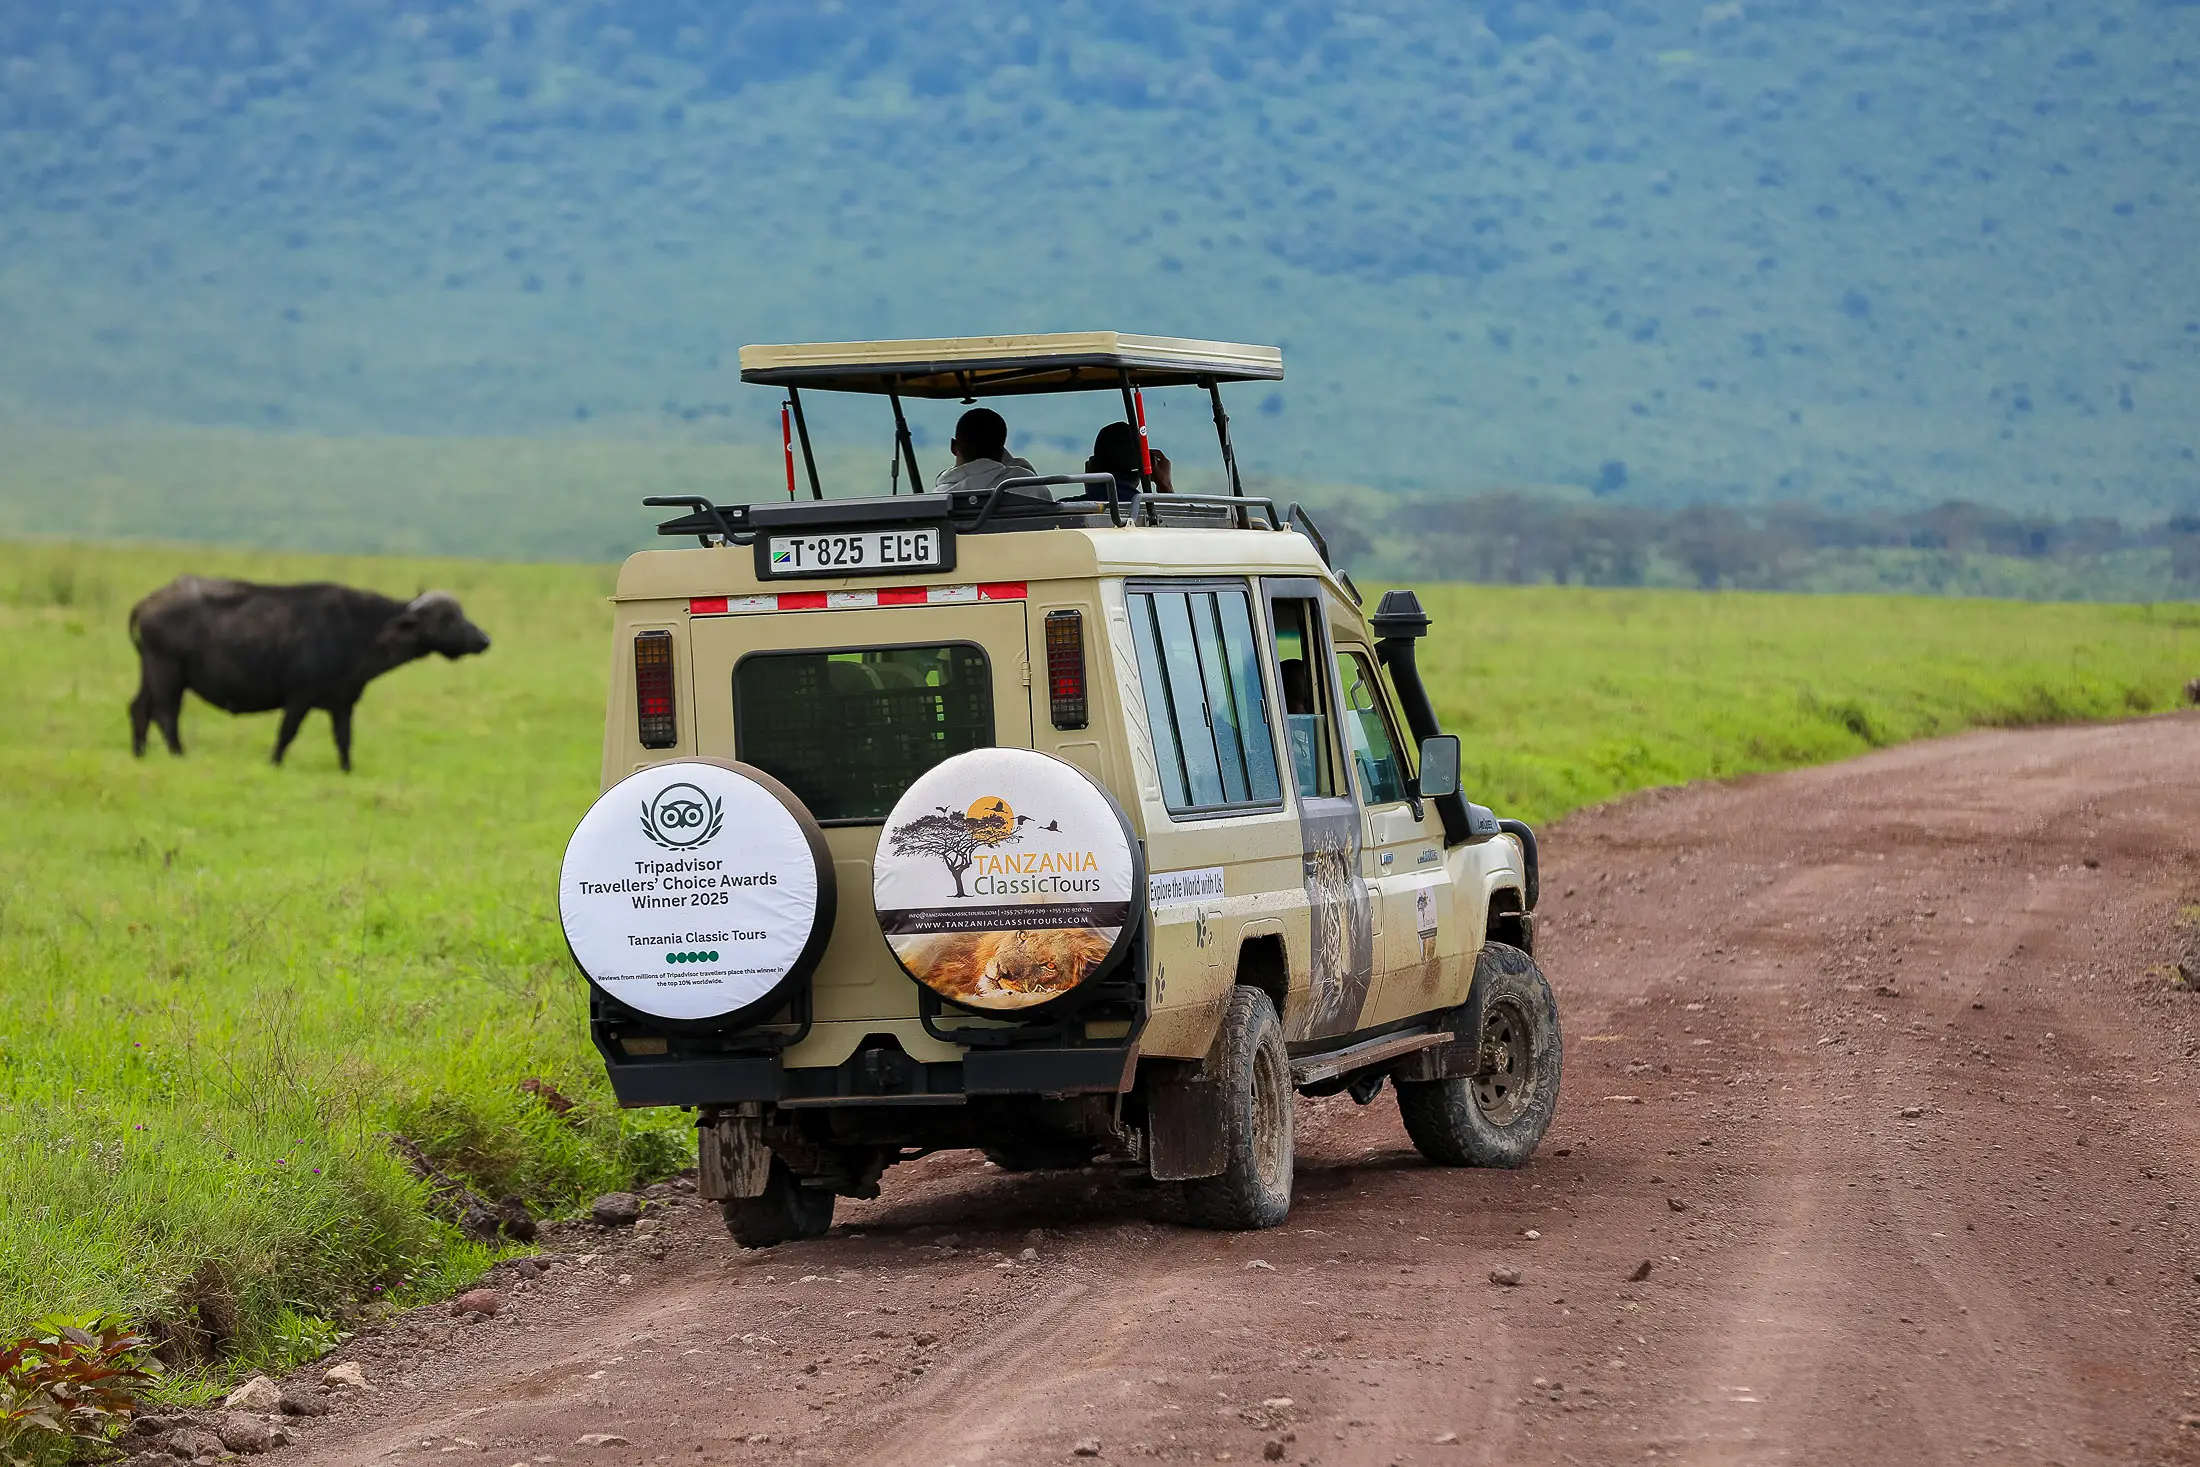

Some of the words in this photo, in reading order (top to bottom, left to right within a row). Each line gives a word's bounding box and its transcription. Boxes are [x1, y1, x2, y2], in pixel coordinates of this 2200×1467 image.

[790, 540, 804, 566] T
[818, 537, 863, 566] 825
[880, 534, 929, 563] ELG
[635, 858, 723, 876] Tripadvisor
[974, 851, 1099, 876] TANZANIA
[579, 877, 659, 895] Travellers’
[663, 874, 716, 890] Choice
[720, 872, 777, 887] Awards
[974, 875, 1100, 896] ClassicTours
[1150, 879, 1171, 906] Explore
[1172, 877, 1182, 897] the
[1183, 874, 1200, 896] World
[1201, 873, 1213, 894] with
[1215, 873, 1223, 893] Us.
[632, 894, 687, 909] Winner
[690, 891, 729, 907] 2025
[915, 917, 1088, 929] WWW.TANZANIACLASSICTOURS.COM
[628, 933, 682, 946] Tanzania
[685, 930, 729, 944] Classic
[732, 929, 767, 941] Tours
[667, 971, 698, 979] Tripadvisor
